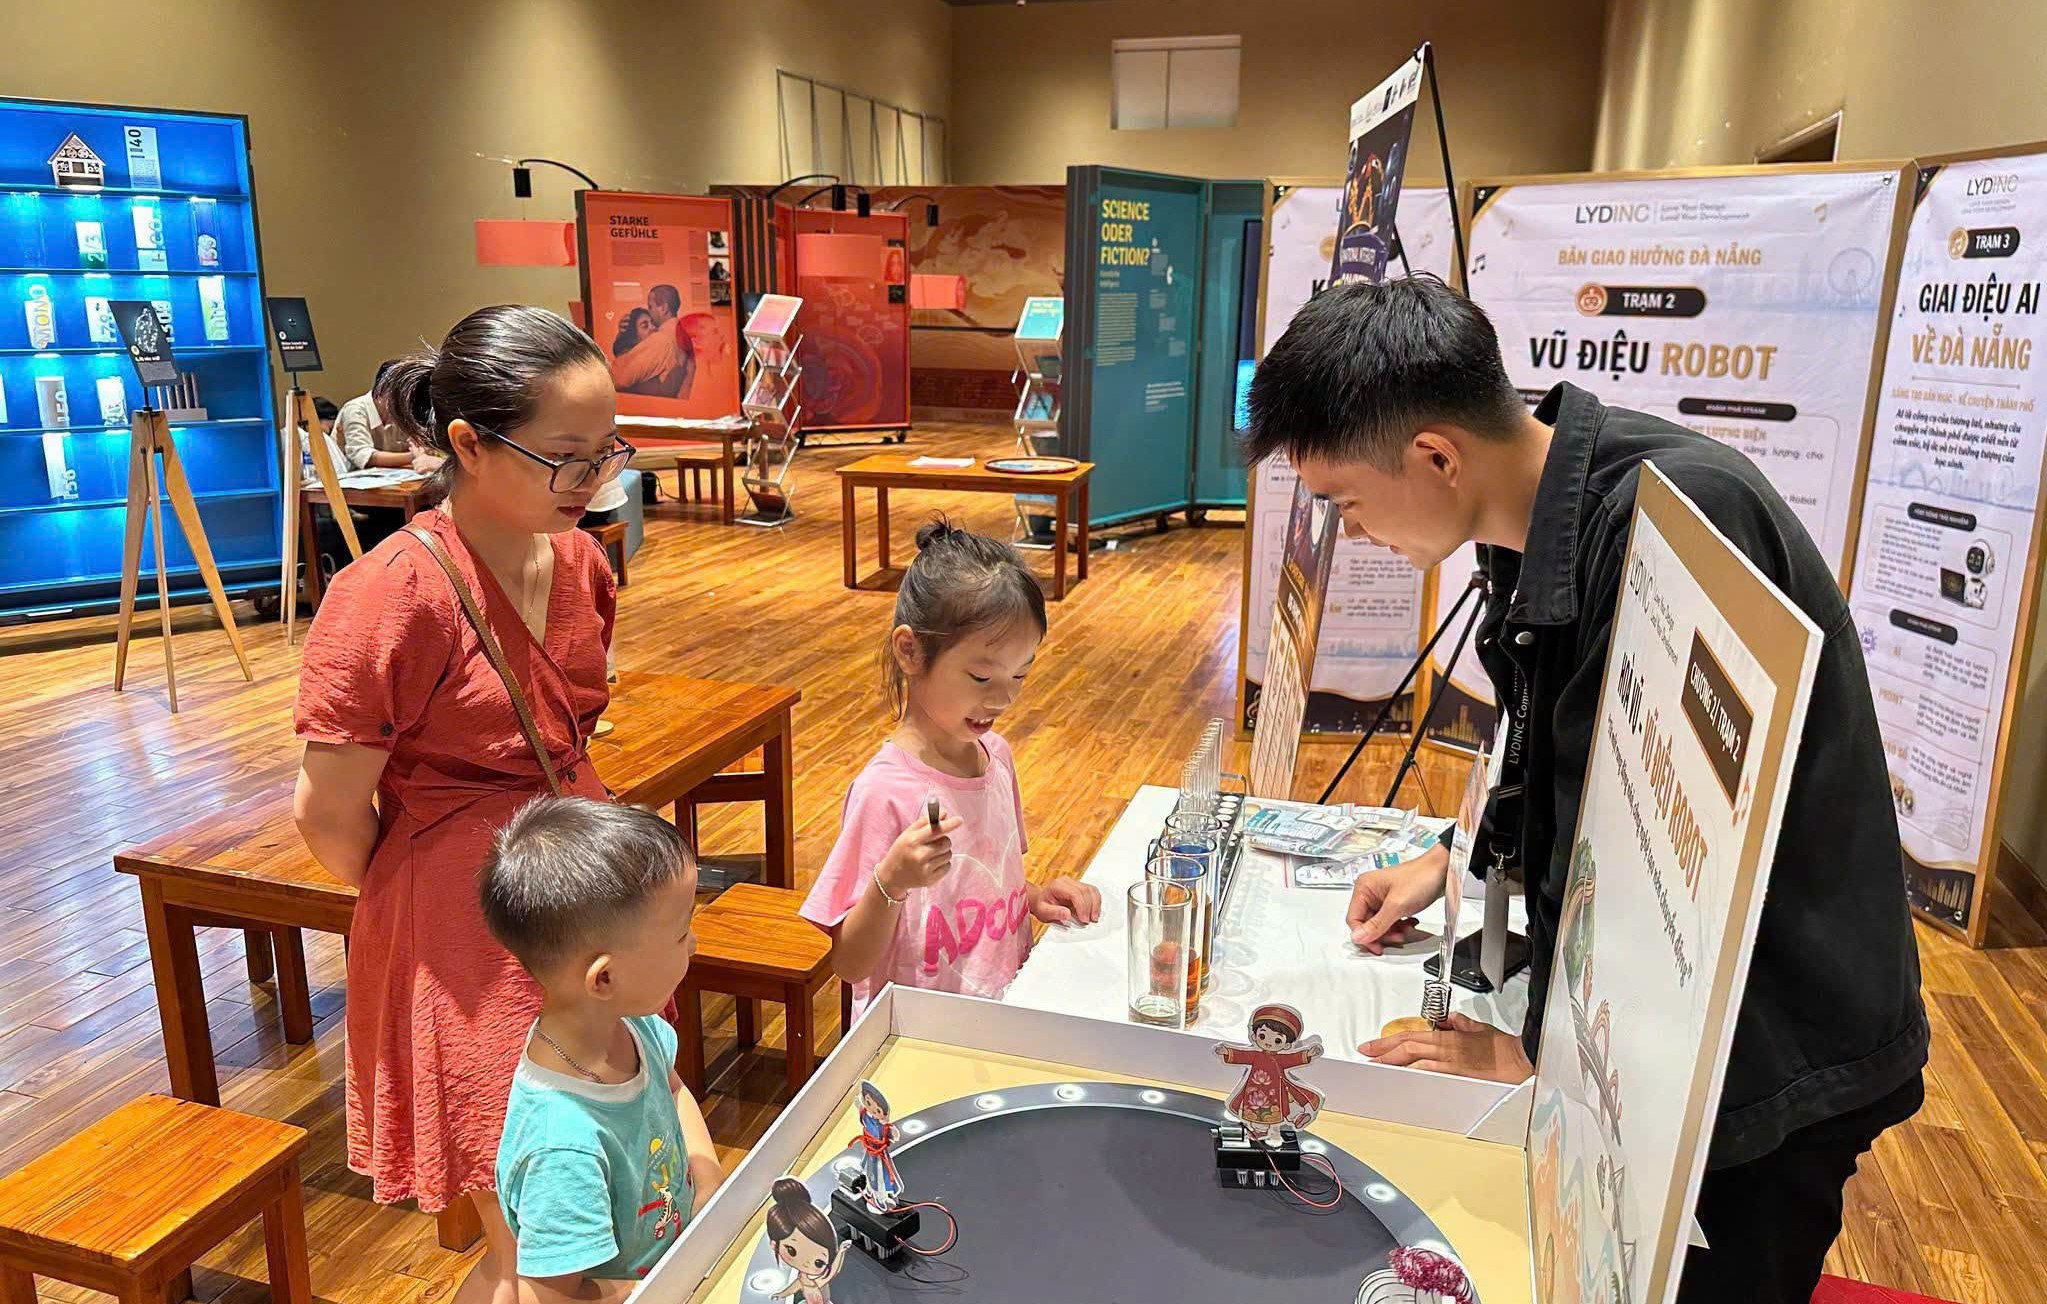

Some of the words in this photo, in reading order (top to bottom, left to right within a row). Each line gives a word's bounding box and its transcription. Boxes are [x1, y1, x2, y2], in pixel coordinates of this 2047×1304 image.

[1966, 174, 2019, 196] LYDINC
[610, 215, 649, 227] STARKE
[1102, 199, 1150, 221] SCIENCE
[1575, 203, 1650, 224] LYDINC
[611, 226, 658, 239] GEFÜHLE
[1101, 223, 1133, 243] ODER
[1975, 235, 2000, 253] TRẠM
[2003, 233, 2010, 249] 3
[1100, 246, 1150, 266] FICTION?
[1558, 244, 1587, 266] BẢN
[1591, 248, 1626, 266] GIAO
[1629, 243, 1685, 267] HƯỞNG
[1688, 242, 1710, 266] ĐÀ
[1714, 240, 1762, 267] NẴNG
[1622, 293, 1661, 312] TRẠM
[1663, 293, 1676, 310] 2
[1919, 283, 1957, 314] GIAI
[1962, 272, 2012, 322] ĐIỆU
[2015, 283, 2040, 314] AI
[1529, 330, 1567, 370] VŨ
[1576, 329, 1650, 381] ĐIỆU
[1660, 342, 1778, 381] ROBOT
[1911, 324, 1937, 364] VỀ
[1939, 326, 1965, 366] ĐÀ
[1970, 323, 2033, 371] NẴNG
[1690, 661, 1713, 714] CHƯƠNG
[1709, 694, 1721, 727] 2/
[1717, 705, 1736, 752] TRẠM
[1732, 734, 1741, 763] 2
[1508, 721, 1525, 765] LYDINC
[1641, 706, 1659, 772] VŨ
[1650, 734, 1675, 820] ĐIỆU
[1668, 780, 1709, 904] ROBOT
